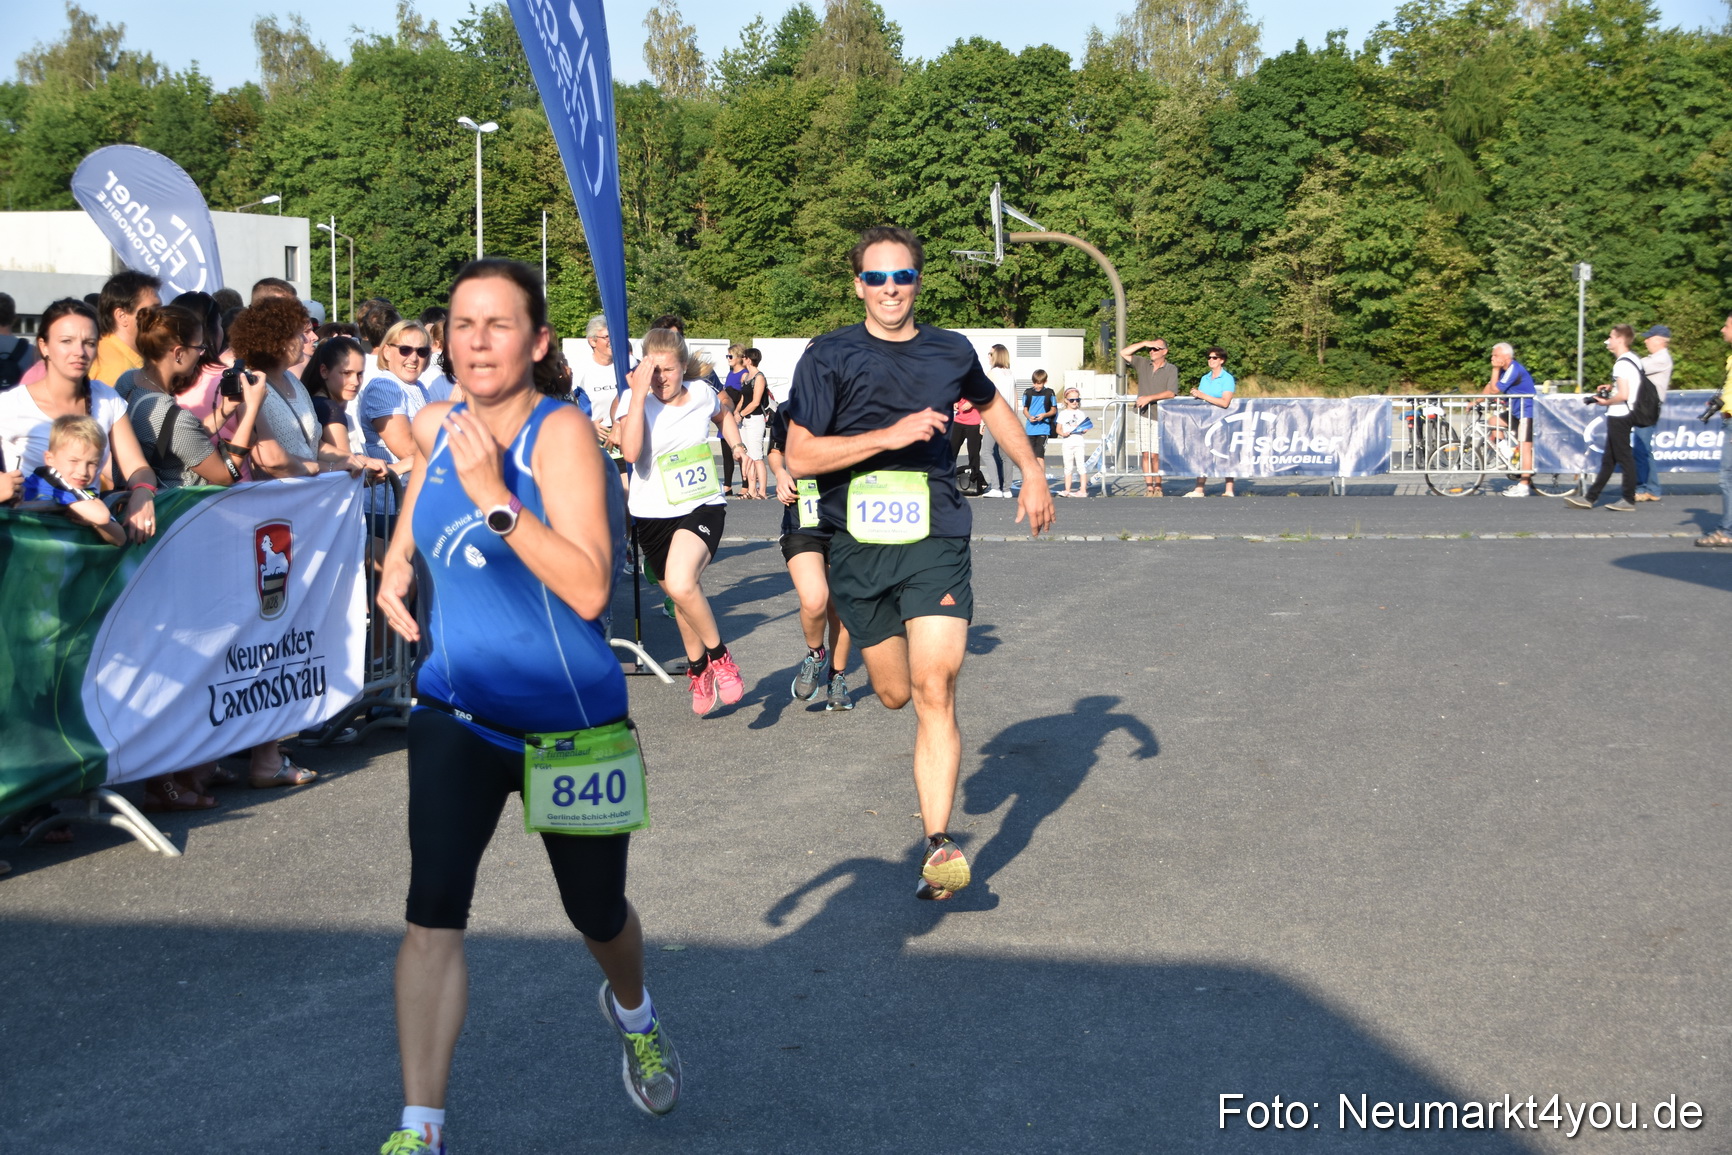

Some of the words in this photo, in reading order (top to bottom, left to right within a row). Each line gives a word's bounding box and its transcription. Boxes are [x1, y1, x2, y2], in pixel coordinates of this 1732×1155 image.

[1229, 430, 1344, 453] Fischer
[225, 459, 239, 478] SONY
[1240, 455, 1334, 465] AUTOMOBILE
[675, 465, 707, 488] 123
[856, 500, 921, 524] 1298
[432, 534, 448, 559] Team
[445, 513, 474, 536] Schick
[454, 708, 473, 722] TAO
[552, 768, 627, 808] 840
[547, 813, 581, 821] Gerlinde
[581, 809, 632, 821] Schick-Huber
